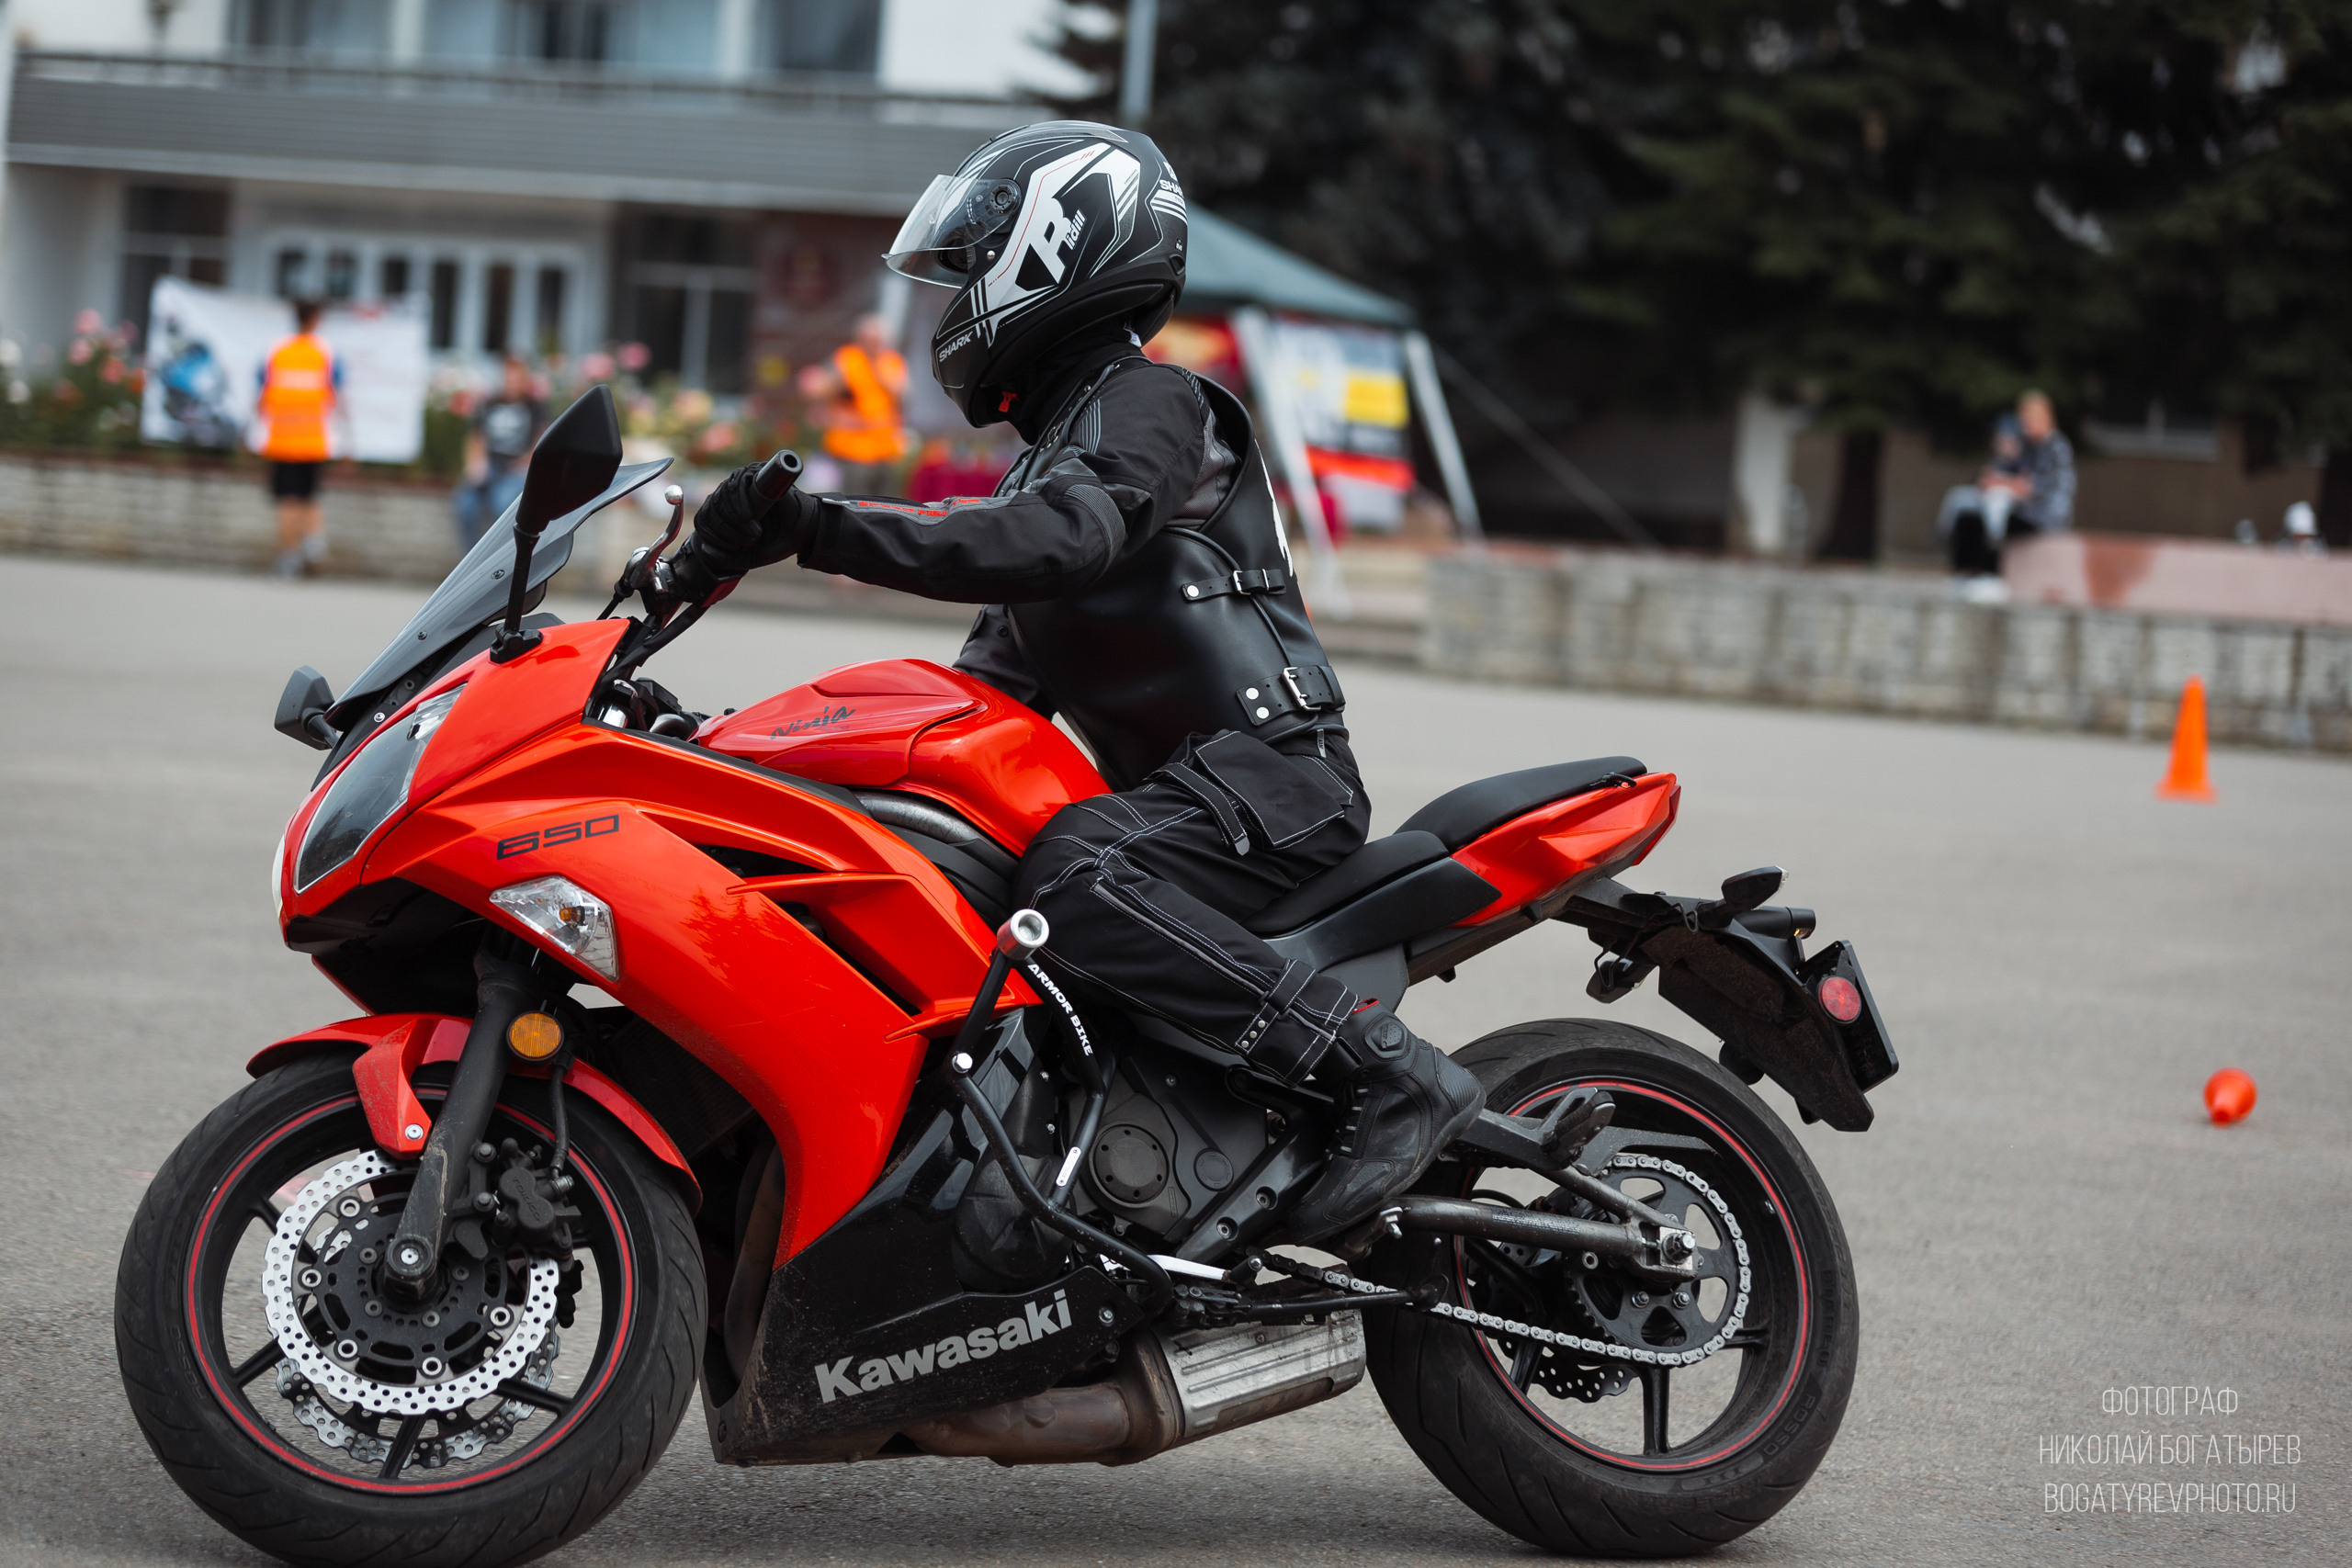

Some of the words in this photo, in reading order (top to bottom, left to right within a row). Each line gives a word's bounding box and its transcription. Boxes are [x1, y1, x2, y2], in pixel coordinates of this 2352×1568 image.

[939, 331, 973, 363] SHARK
[496, 814, 620, 861] 650
[1027, 964, 1073, 1014] ARMOR
[1069, 1014, 1093, 1056] BIKE
[511, 1176, 540, 1221] TOKICO
[169, 1325, 207, 1401] ROSSO
[814, 1288, 1072, 1404] Kawasaki
[1764, 1393, 1816, 1455] ROSSO
